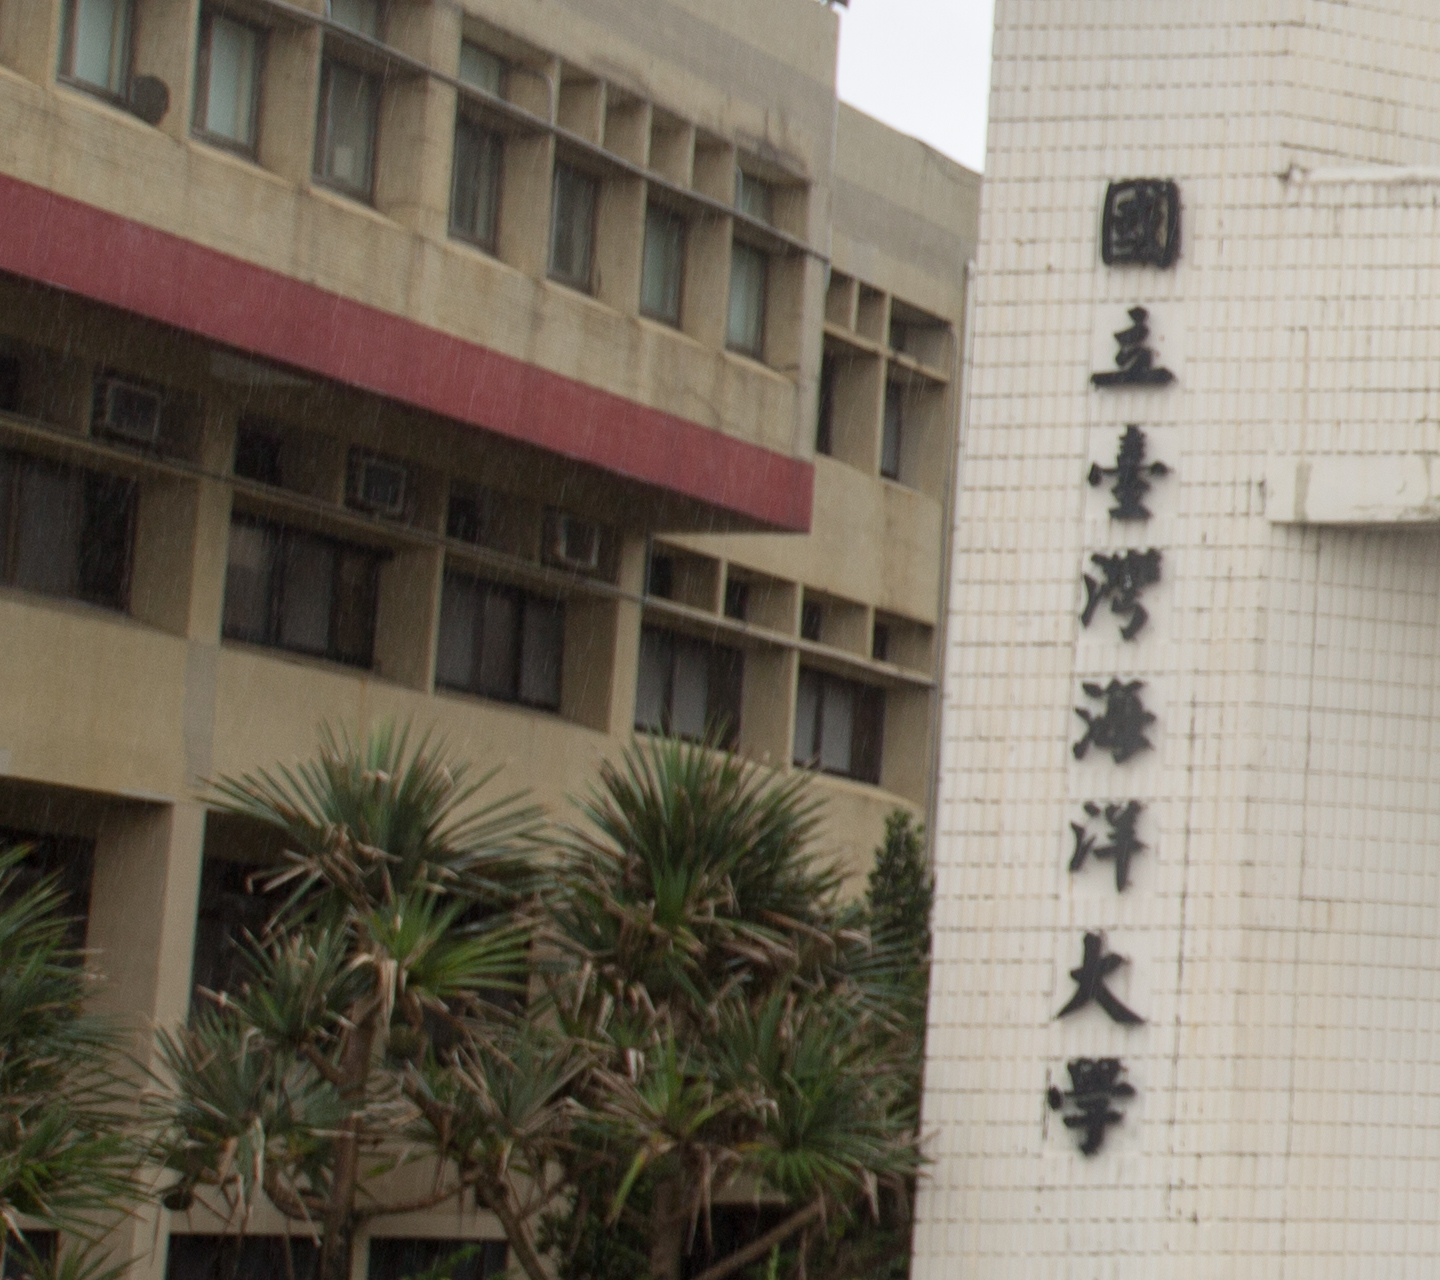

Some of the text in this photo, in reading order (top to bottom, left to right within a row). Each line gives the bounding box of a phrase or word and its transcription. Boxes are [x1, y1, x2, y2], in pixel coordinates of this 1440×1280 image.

[1048, 179, 1181, 1157] 國立臺灣海洋大學
